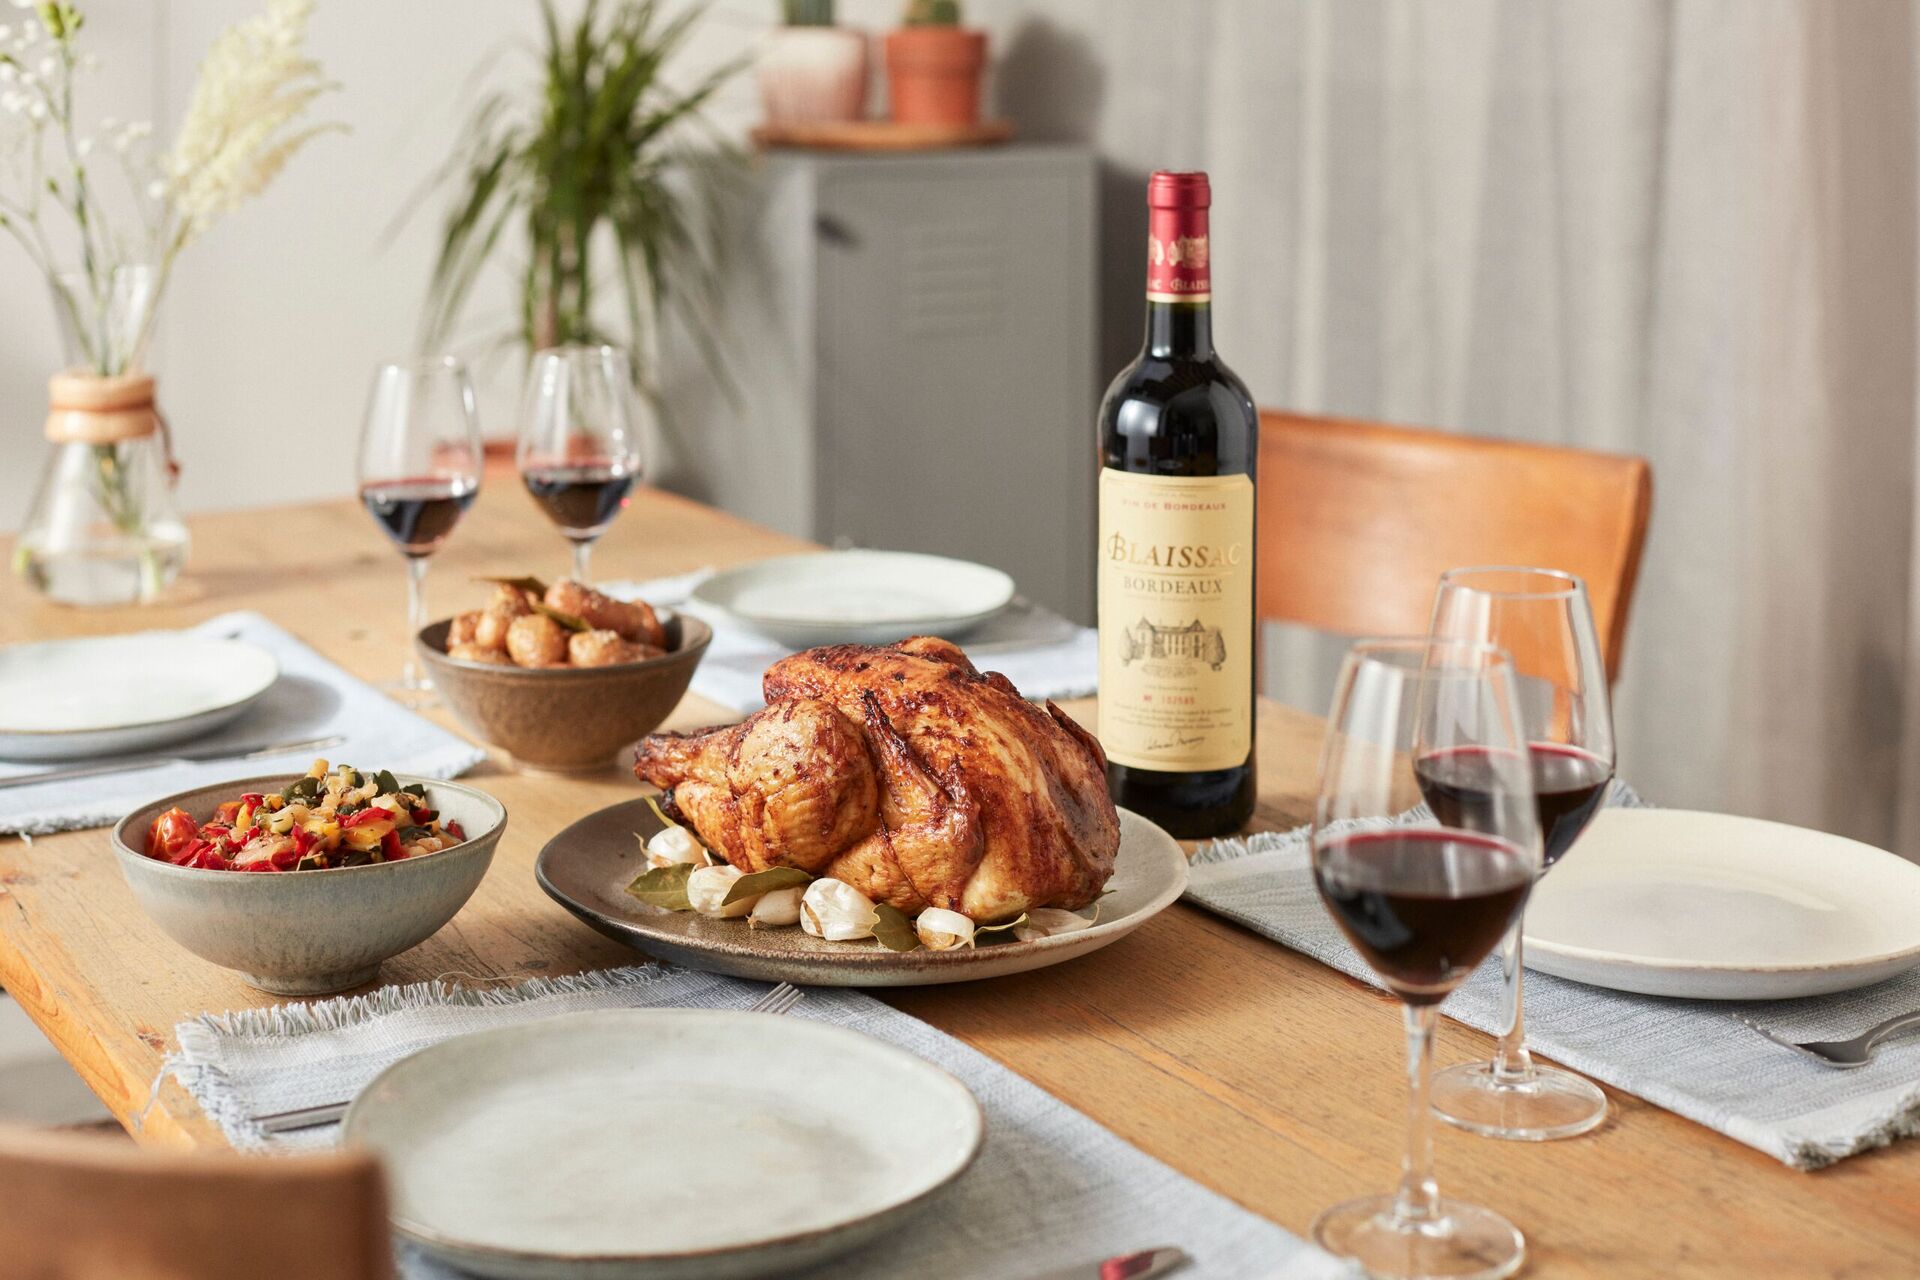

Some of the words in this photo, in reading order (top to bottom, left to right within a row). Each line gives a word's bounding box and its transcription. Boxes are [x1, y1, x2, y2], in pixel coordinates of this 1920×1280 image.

[1122, 499, 1139, 507] VIN
[1144, 501, 1158, 509] DE
[1164, 502, 1226, 511] BORDEAUX
[1107, 531, 1241, 568] BLAISSAC
[1124, 576, 1222, 594] BORDEAUX
